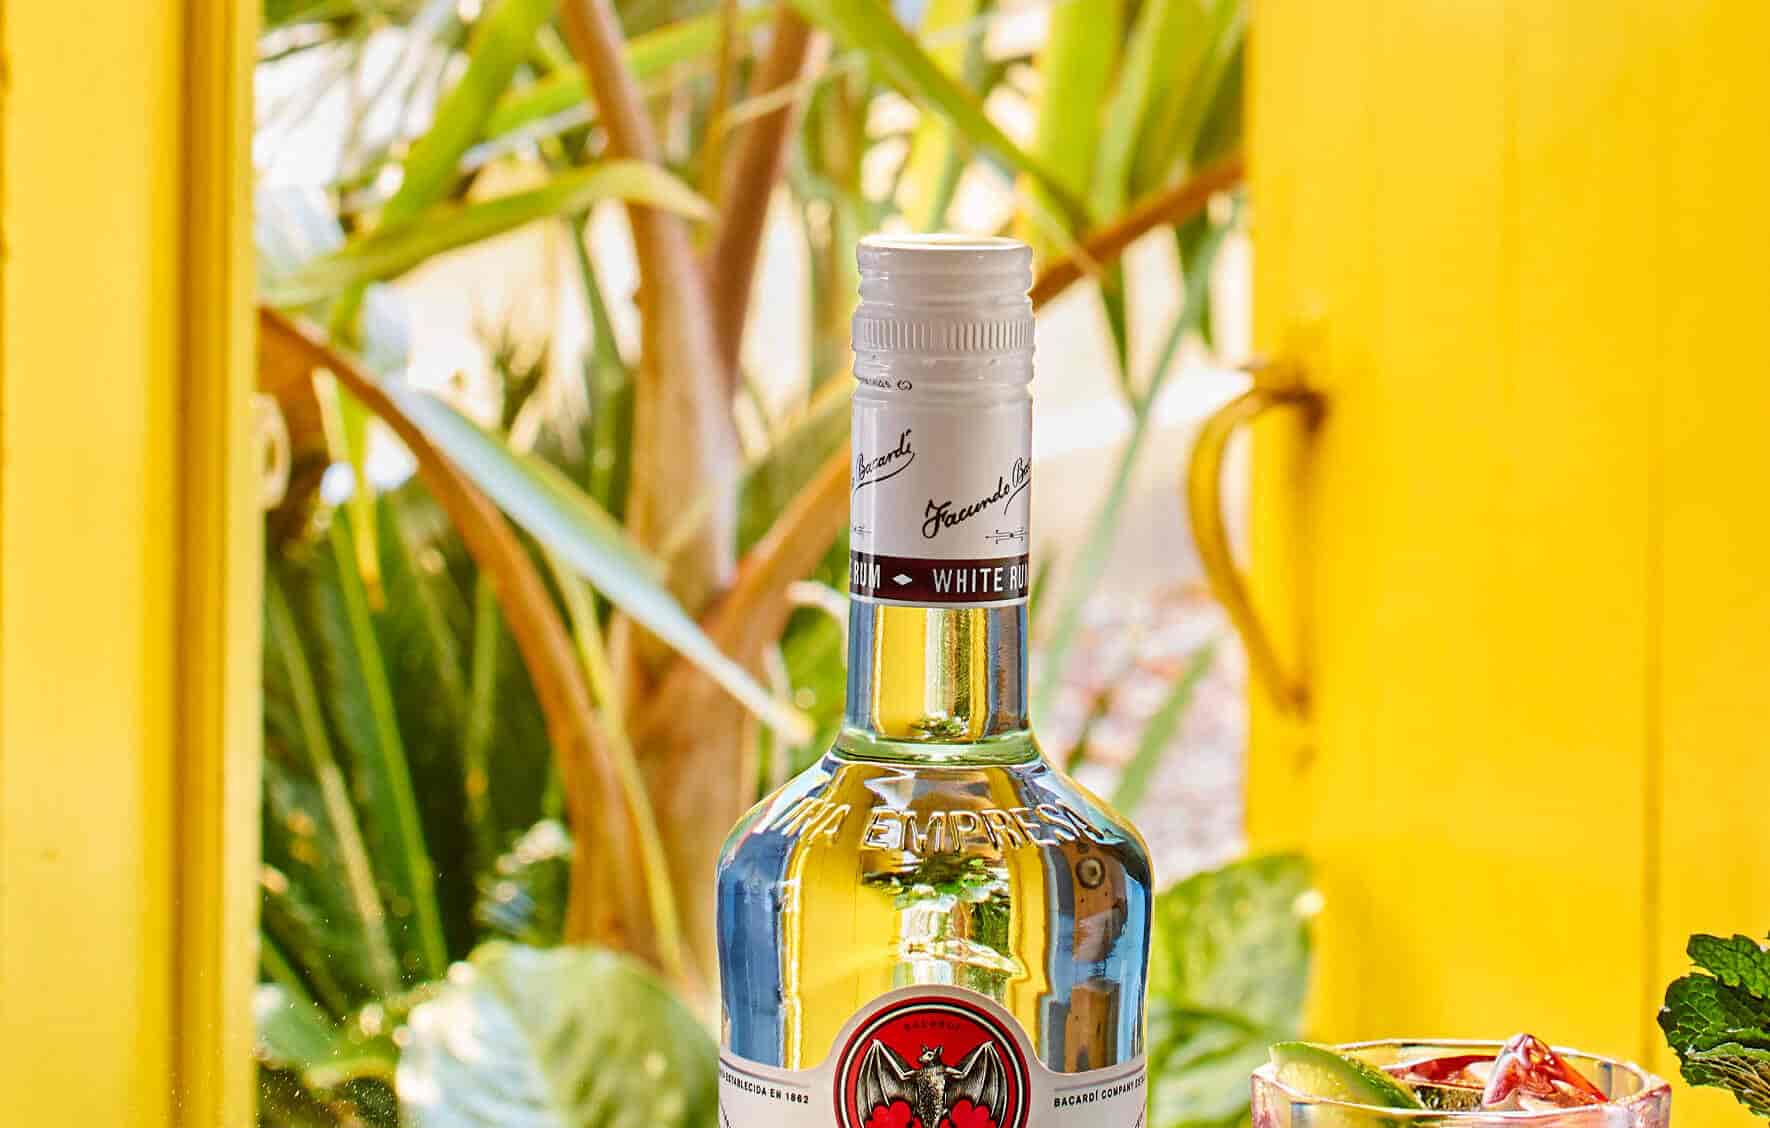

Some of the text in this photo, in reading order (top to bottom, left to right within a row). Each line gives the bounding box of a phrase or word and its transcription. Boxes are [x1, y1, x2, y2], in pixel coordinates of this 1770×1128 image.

[922, 476, 1011, 539] Facundo
[853, 559, 881, 590] RUM
[933, 567, 1004, 593] WHITE
[769, 1088, 782, 1099] EN
[785, 1092, 809, 1105] 1862
[1101, 1081, 1134, 1100] COMPANY
